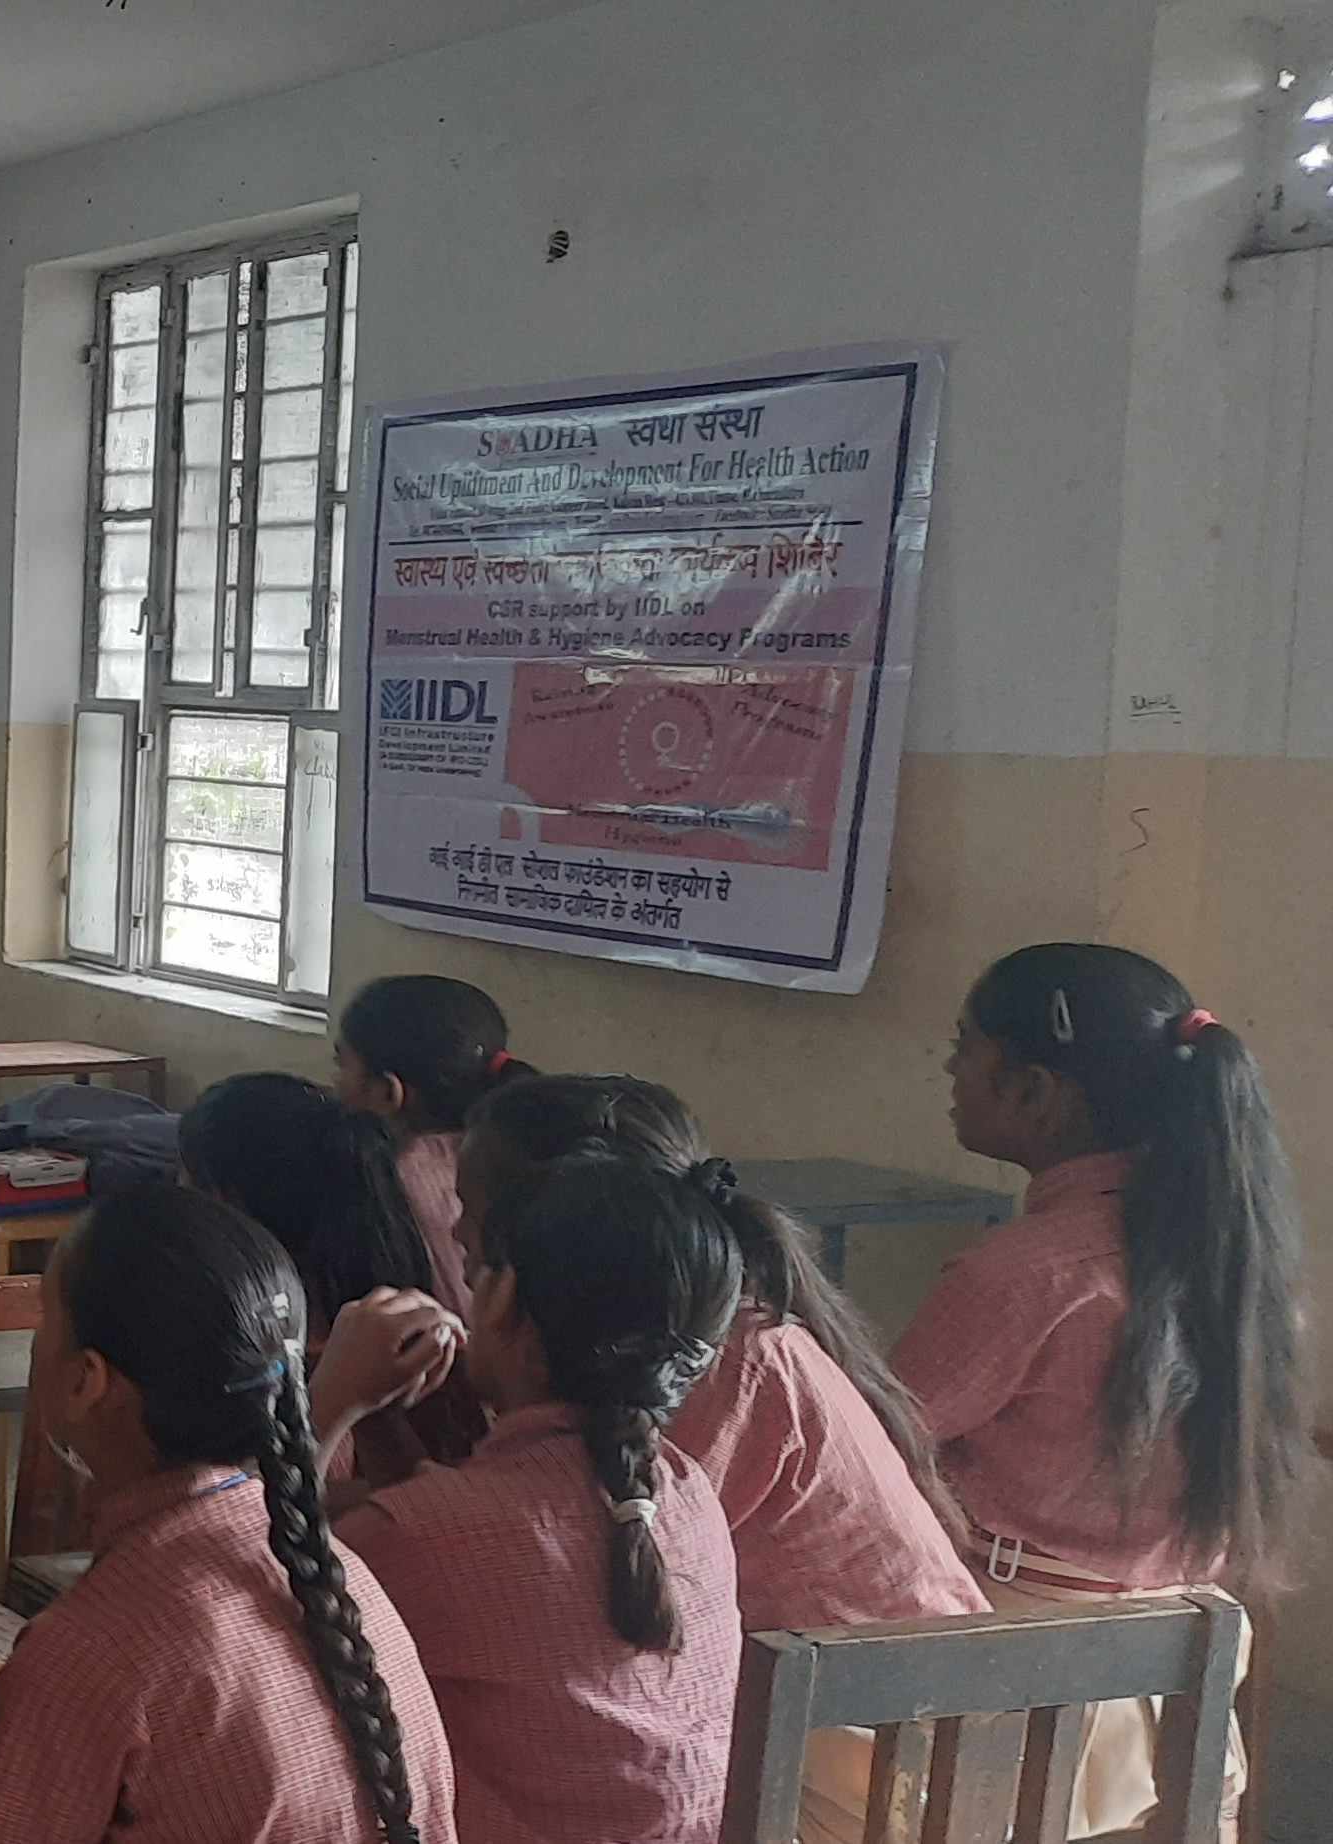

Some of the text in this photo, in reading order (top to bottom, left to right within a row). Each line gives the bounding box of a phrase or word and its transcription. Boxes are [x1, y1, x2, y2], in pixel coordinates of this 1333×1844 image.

[620, 404, 765, 446] स्वधा संस्था
[689, 452, 723, 482] For
[728, 446, 794, 481] Health
[799, 442, 870, 475] Action
[488, 597, 705, 621] CSR support by IIDL on
[467, 629, 523, 646] Health
[548, 628, 624, 650] Hygiene
[631, 627, 731, 651] Advocacy
[740, 627, 851, 652] Programs
[415, 679, 498, 724] IIDL
